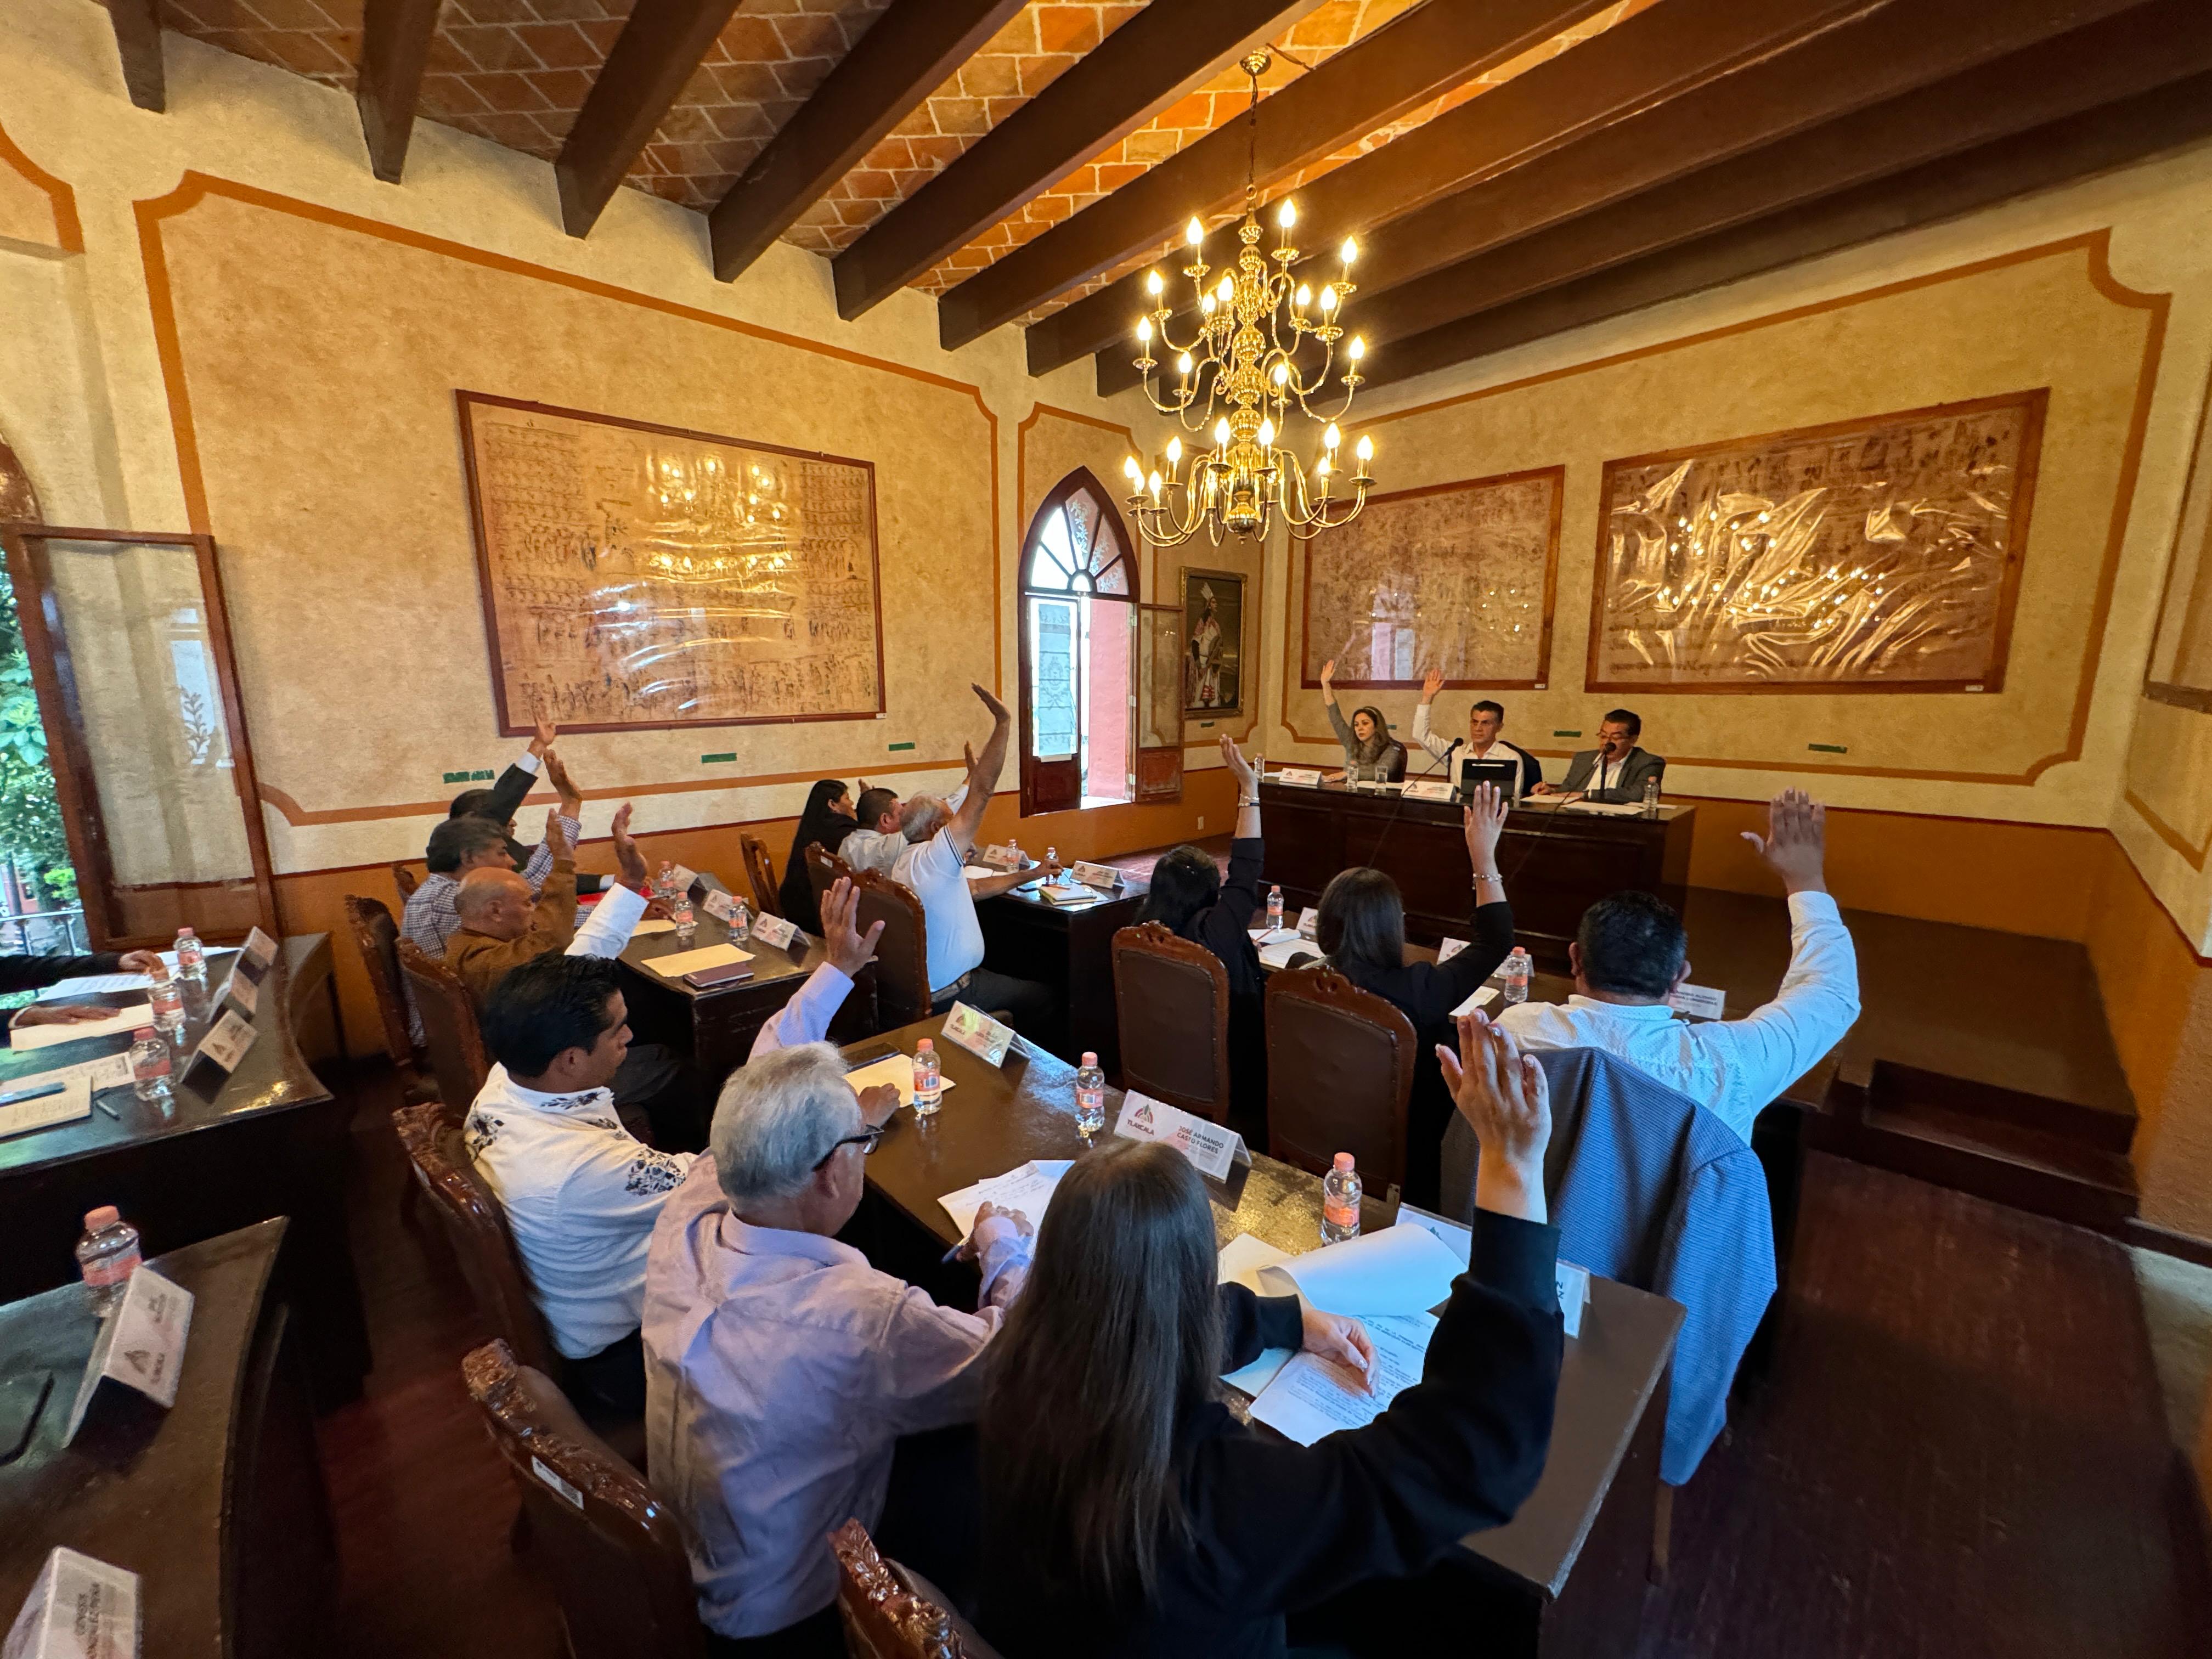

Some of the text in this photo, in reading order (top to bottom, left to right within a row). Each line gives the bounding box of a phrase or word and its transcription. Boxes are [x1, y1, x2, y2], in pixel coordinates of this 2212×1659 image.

[1127, 1119, 1154, 1136] TLAXCALA
[1178, 1125, 1224, 1149] JOSÉ ARMANDO
[1197, 1141, 1218, 1154] FLORES
